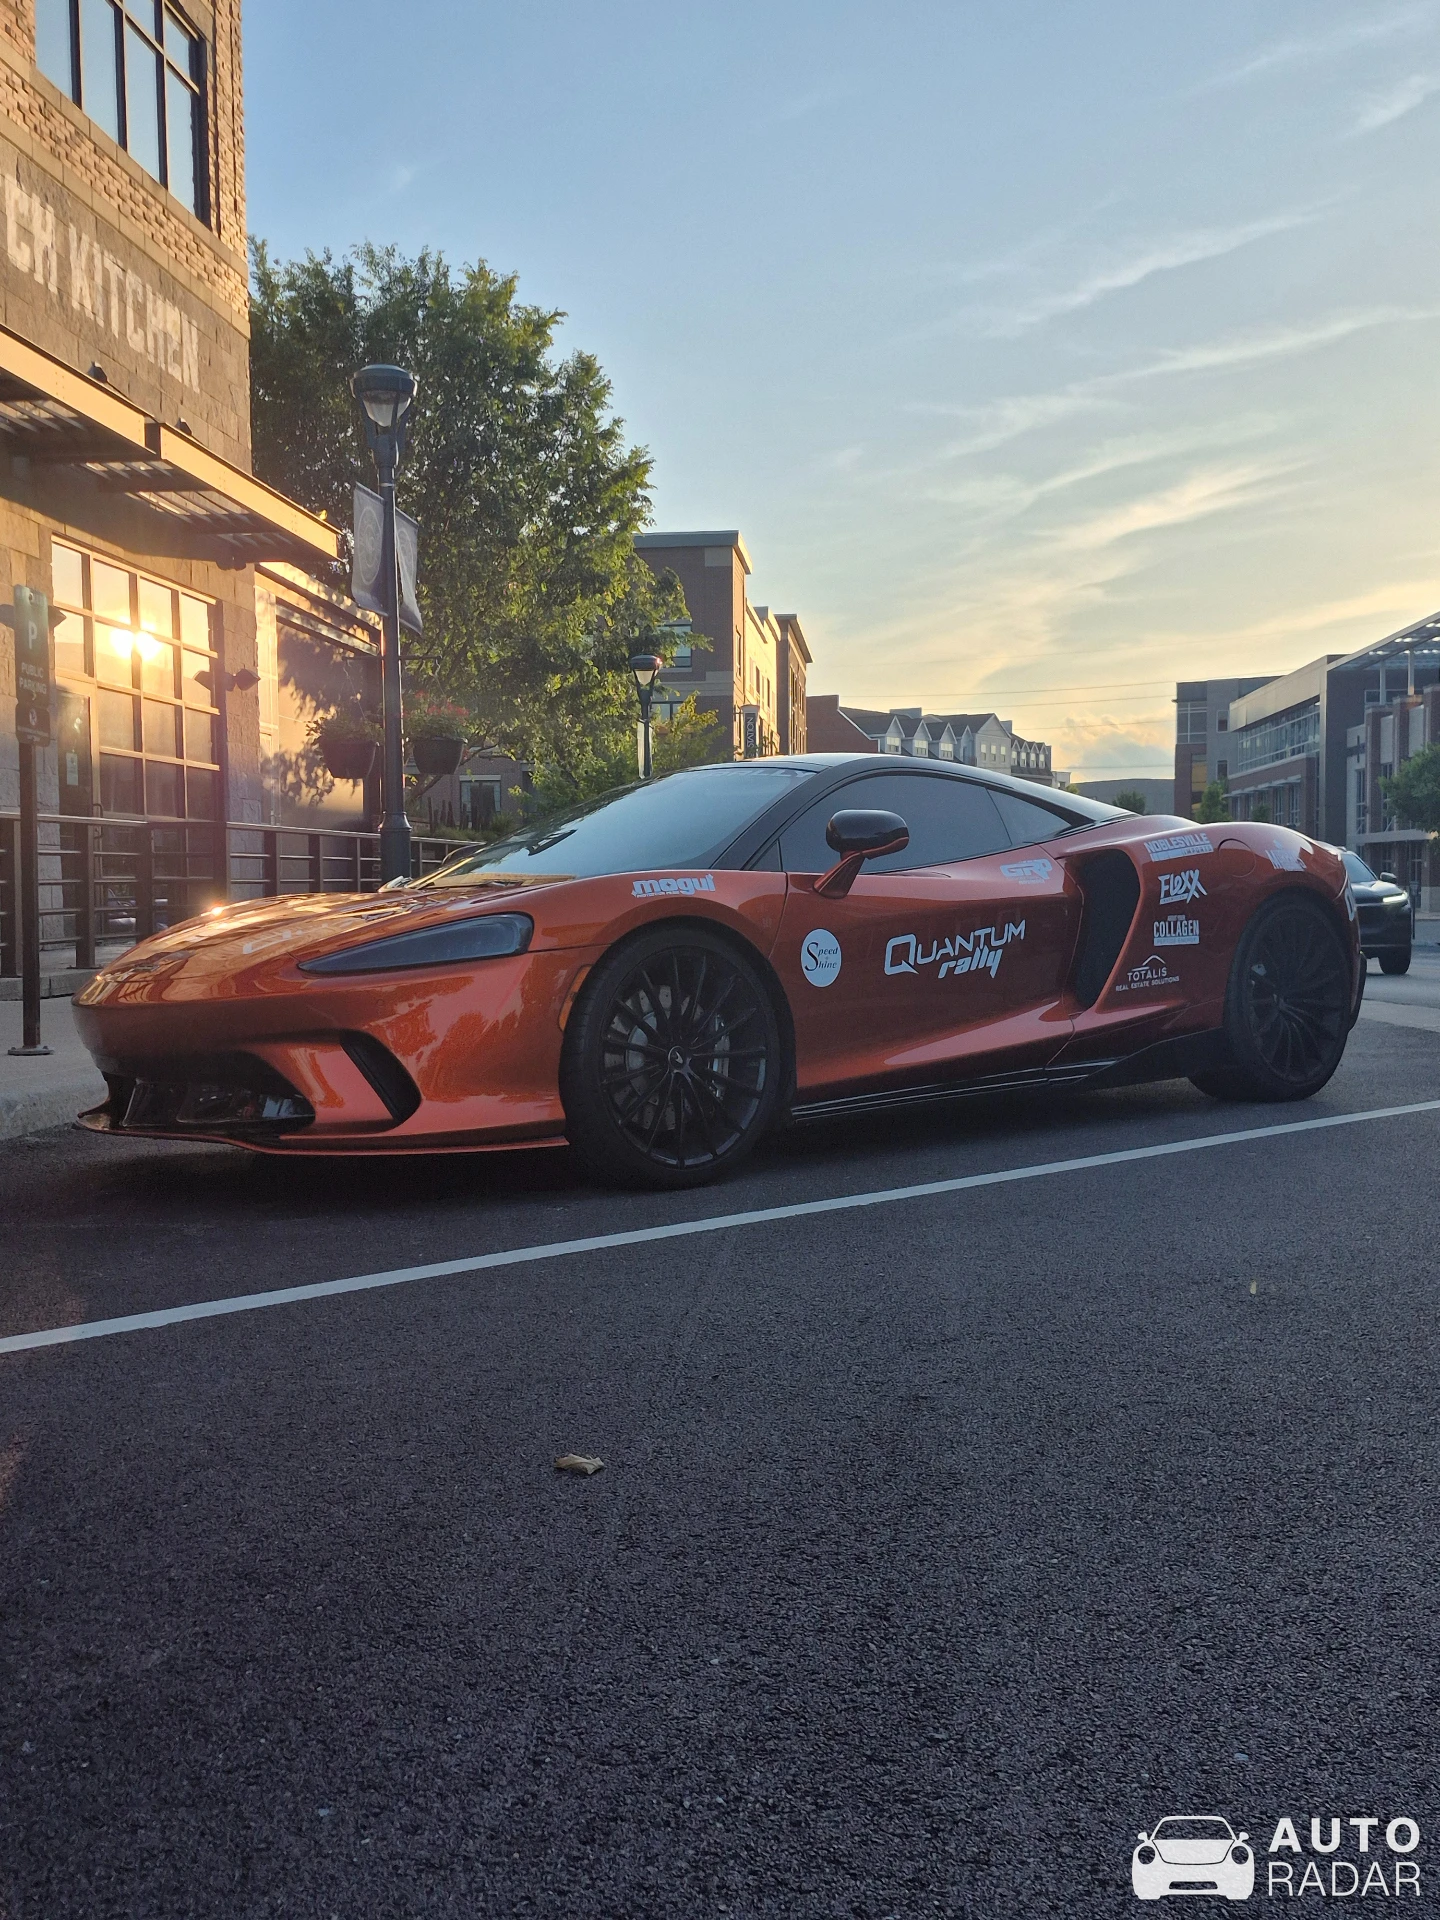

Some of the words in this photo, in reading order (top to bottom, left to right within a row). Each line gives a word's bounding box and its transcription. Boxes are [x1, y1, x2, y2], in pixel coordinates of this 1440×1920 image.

[68, 221, 200, 393] KITCHEN
[28, 620, 37, 650] P
[21, 661, 44, 679] PUBLIC
[19, 677, 47, 695] PARKING
[1144, 833, 1210, 853] NOBLESVILLE
[1153, 920, 1199, 937] COLLAGEN
[884, 919, 1026, 976] QUANTUM
[938, 944, 1003, 979] rally
[1127, 966, 1168, 982] TOTALIS
[1130, 980, 1150, 989] ESTATE
[1151, 976, 1180, 986] SOLUTIONS
